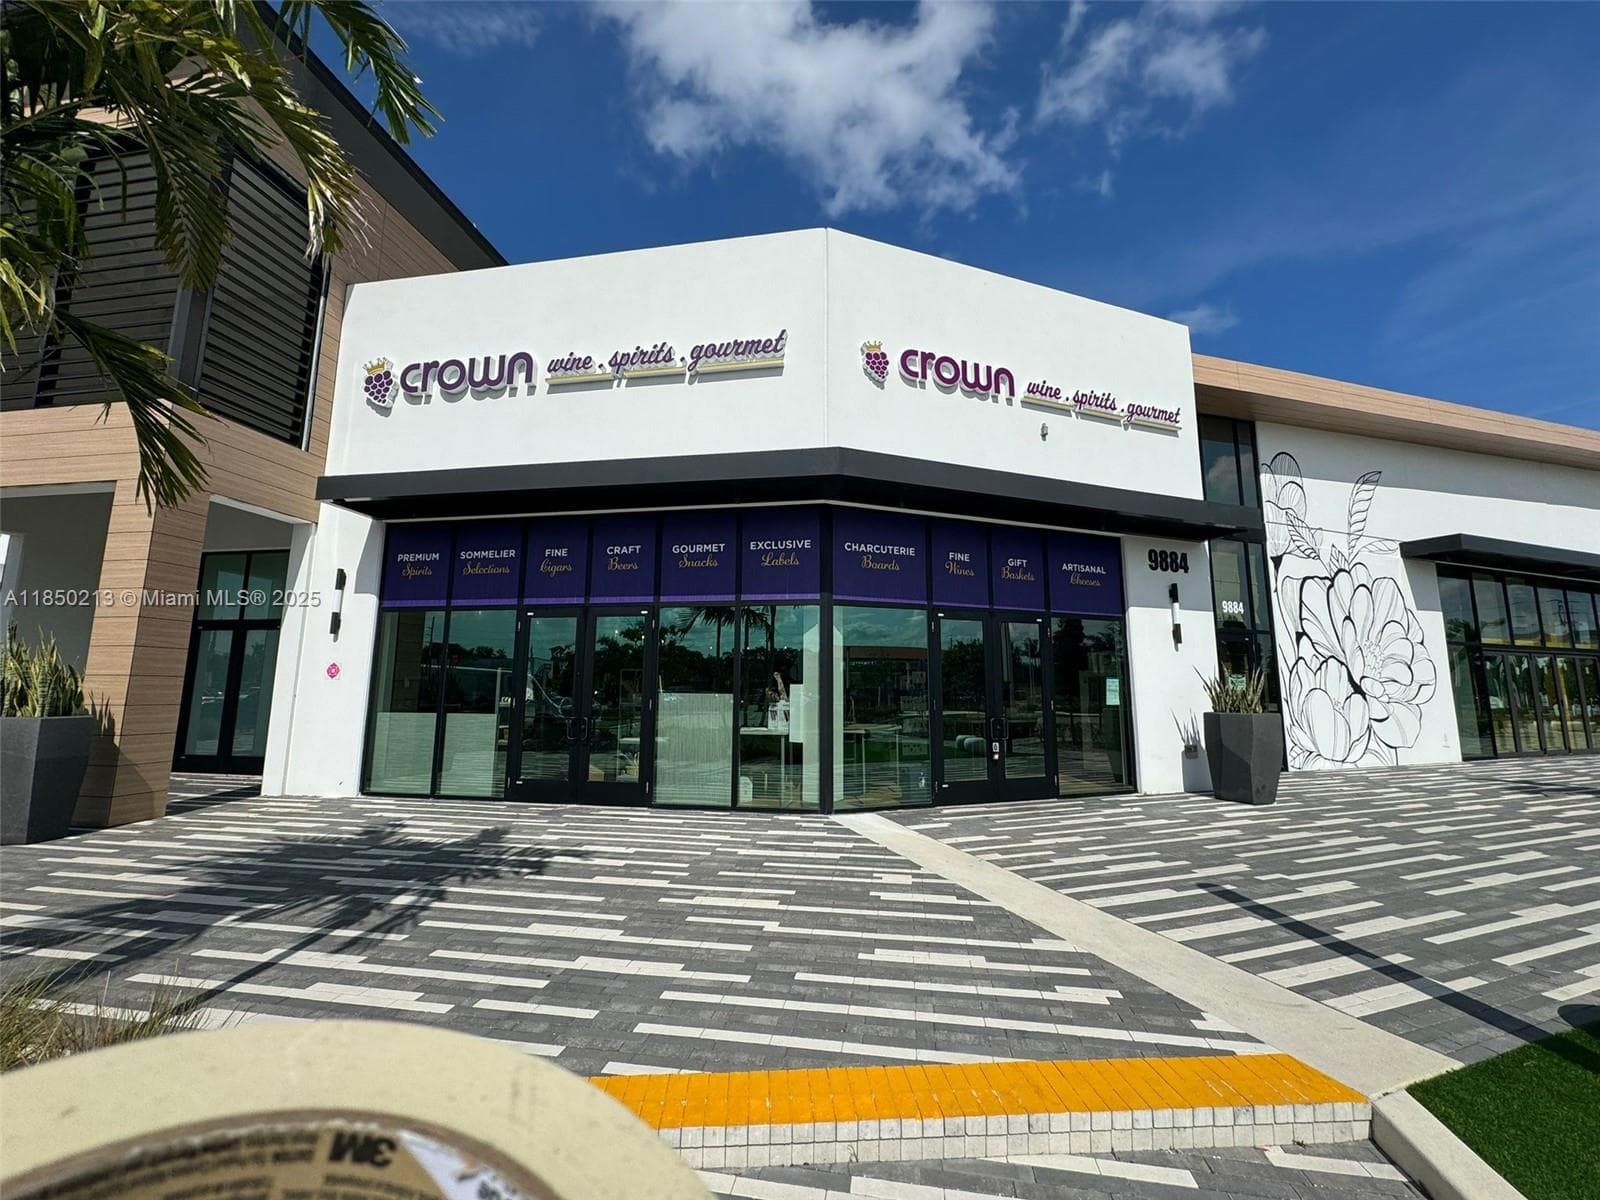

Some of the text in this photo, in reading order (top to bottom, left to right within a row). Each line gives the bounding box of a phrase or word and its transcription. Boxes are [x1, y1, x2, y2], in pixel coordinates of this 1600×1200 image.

[400, 351, 534, 393] crown
[547, 356, 592, 374] wine
[609, 342, 673, 378] spirits
[687, 329, 786, 370] gourmet
[900, 349, 1015, 397] crown
[1027, 380, 1061, 401] wine
[1073, 389, 1118, 412] spirits
[1126, 404, 1181, 424] gourmet
[606, 545, 641, 555] CRAFT
[672, 543, 726, 554] GOURMET
[750, 539, 812, 551] EXCLUSIVE
[844, 542, 916, 556] CHARCUTERIE
[397, 553, 440, 562] PREMIUM
[460, 549, 516, 560] SOMMELIER
[545, 548, 568, 557] FINE
[760, 552, 800, 567] Labels
[949, 552, 970, 562] FINE
[607, 556, 640, 570] Beers
[679, 554, 719, 568] Snacks
[861, 555, 900, 571] Boards
[1008, 558, 1027, 568] GIFT
[1148, 549, 1189, 573] 9884
[402, 562, 433, 579] Spirits
[463, 562, 510, 576] Selections
[540, 560, 572, 578] Cigars
[945, 561, 975, 576] Wines
[1001, 566, 1035, 581] Baskets
[1062, 563, 1107, 574] ARTISANAL
[1069, 573, 1101, 586] Cheeses
[1222, 601, 1244, 614] 9884
[328, 1130, 397, 1168] 3M
